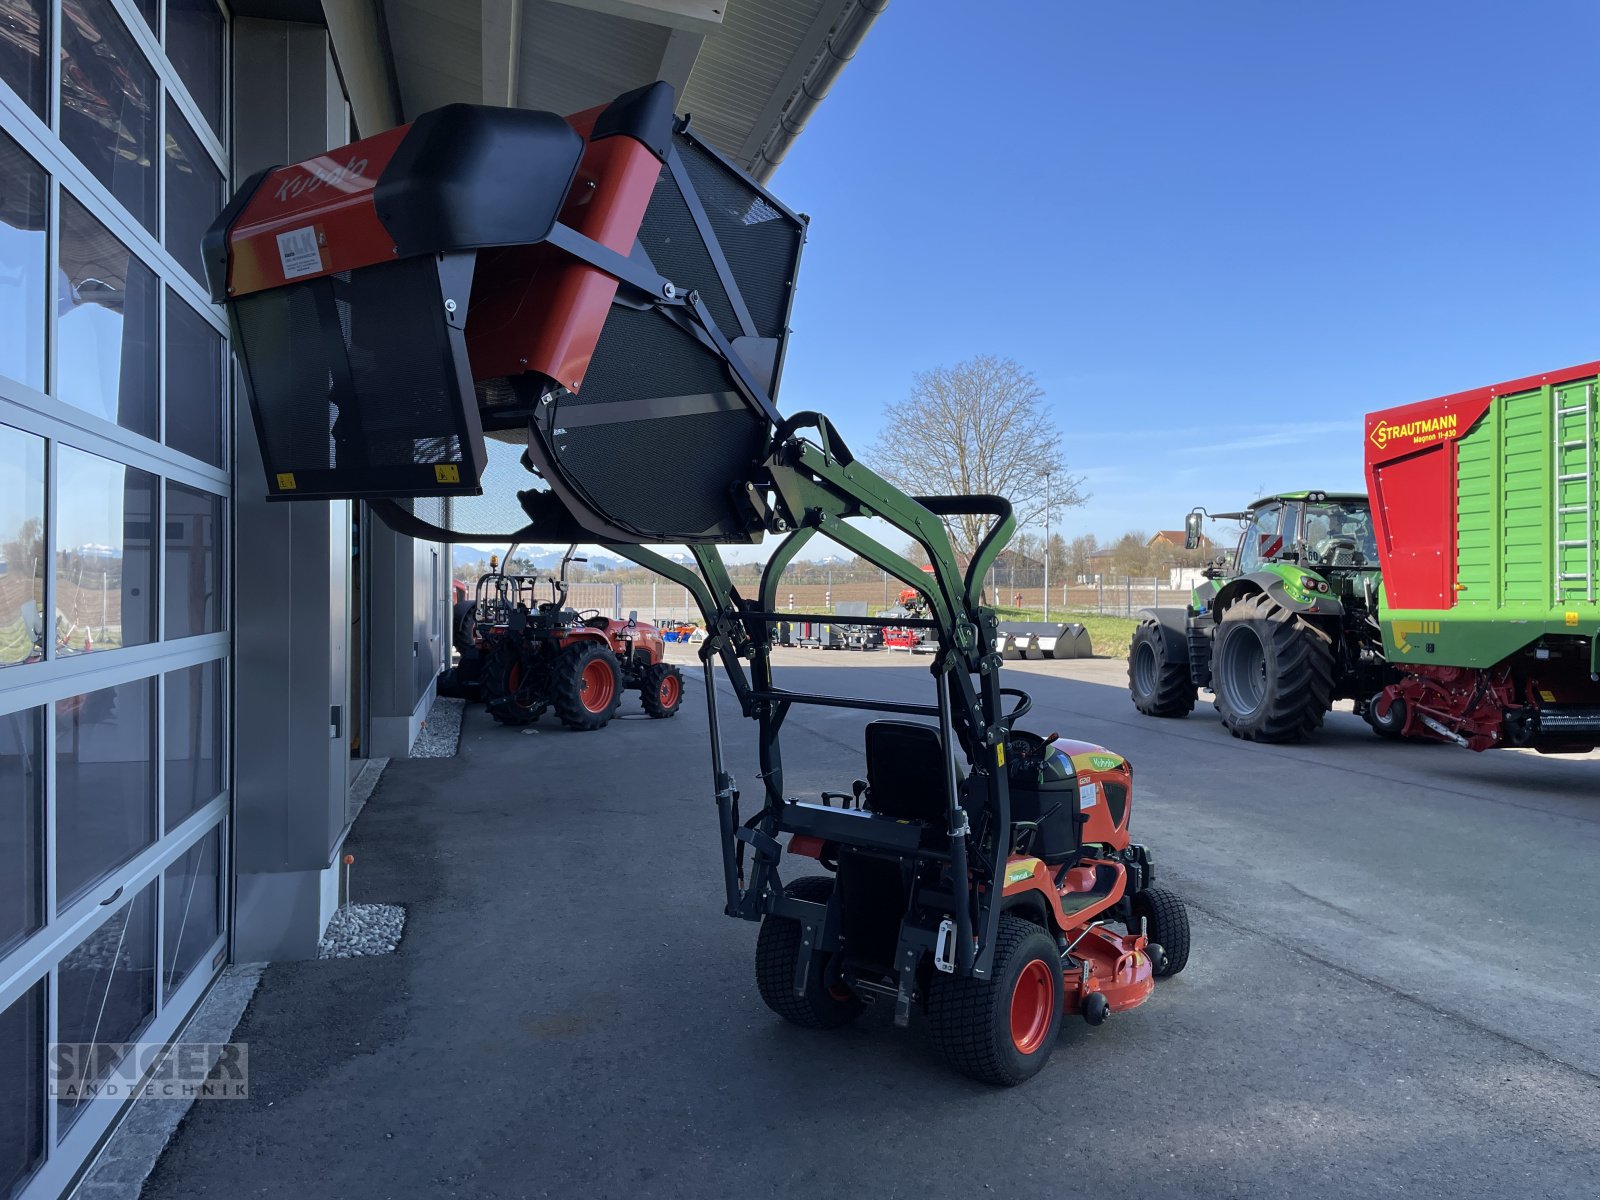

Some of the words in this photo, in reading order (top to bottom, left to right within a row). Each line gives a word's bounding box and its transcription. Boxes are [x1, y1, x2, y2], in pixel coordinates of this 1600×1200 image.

[274, 156, 368, 202] Kubota
[1378, 414, 1456, 443] STRAUTMANN
[1413, 434, 1436, 444] Magnon
[1308, 551, 1318, 561] 60
